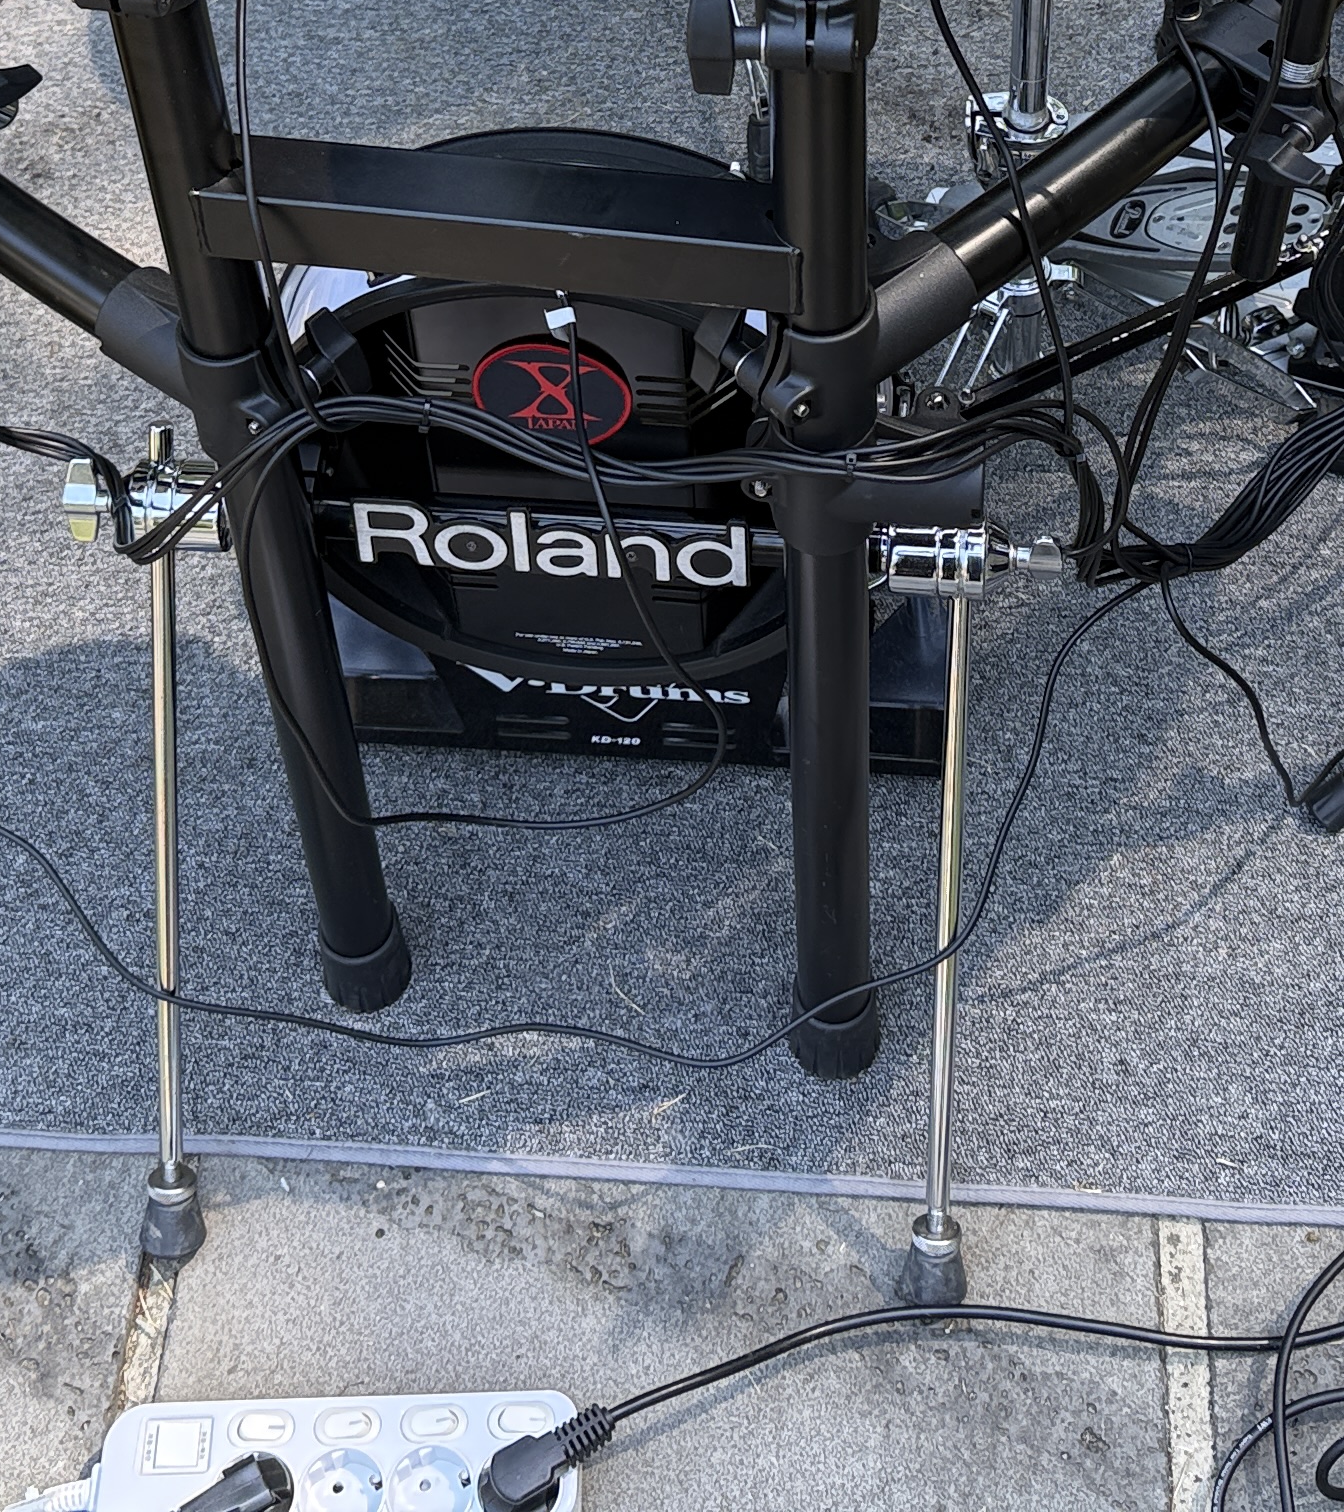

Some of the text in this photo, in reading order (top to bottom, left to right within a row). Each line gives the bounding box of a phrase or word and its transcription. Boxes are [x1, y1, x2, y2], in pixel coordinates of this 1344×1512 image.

[503, 360, 603, 422] X
[353, 502, 748, 588] Roland
[591, 734, 641, 746] KD-120
